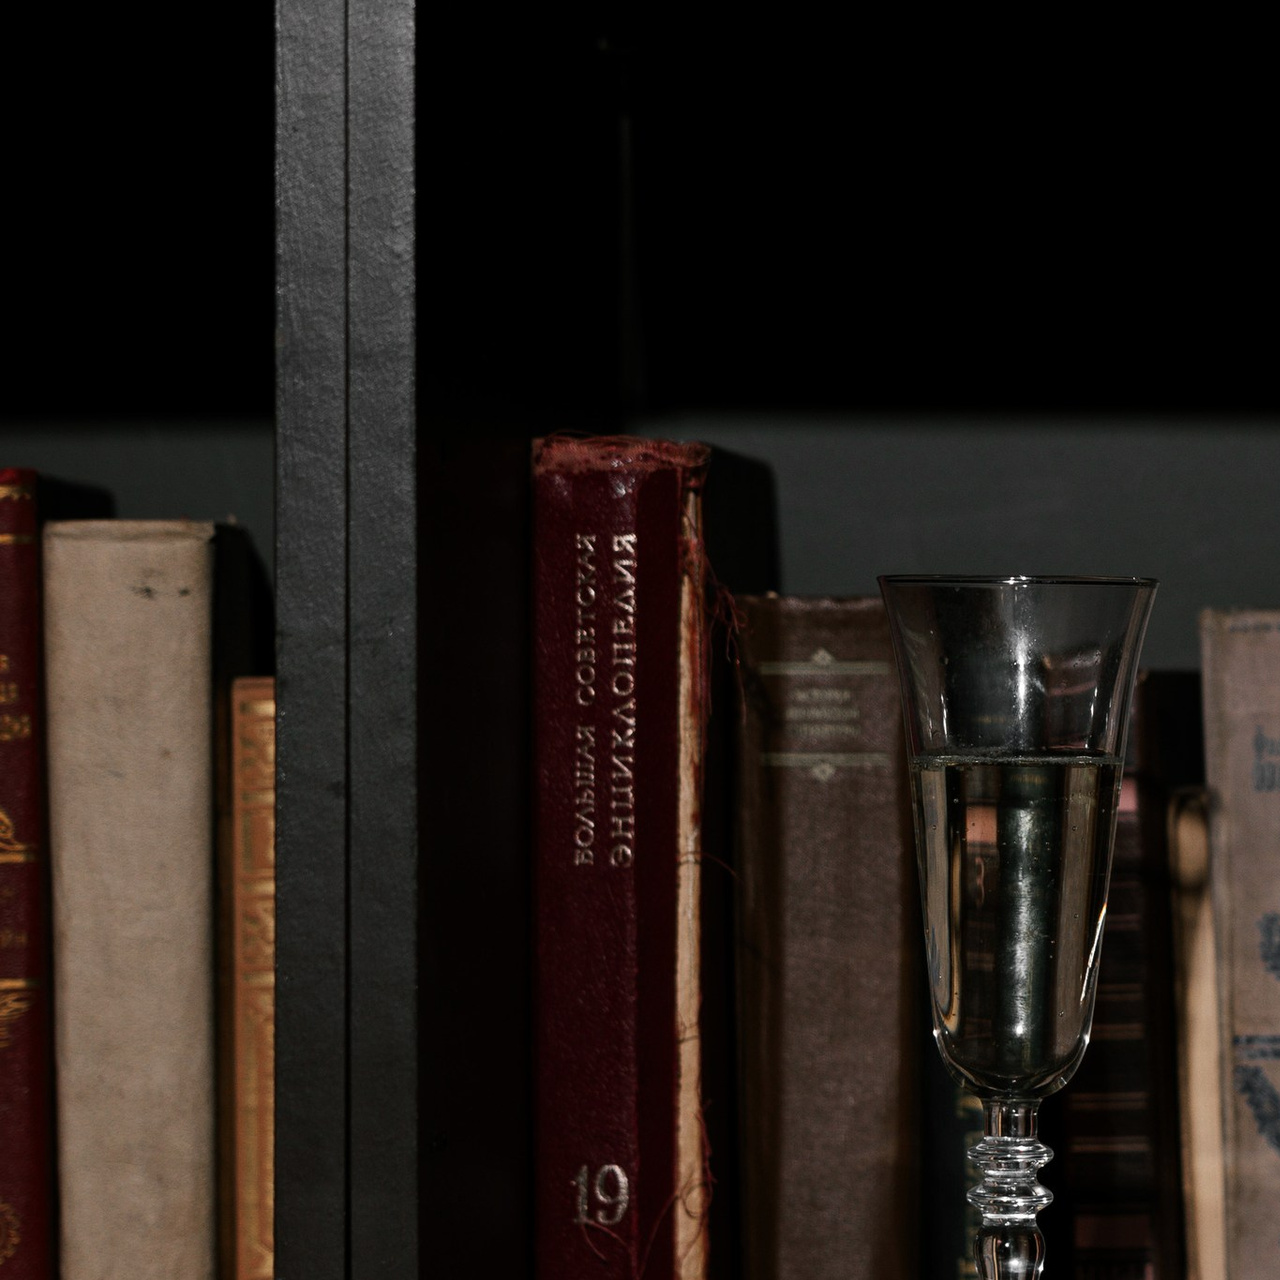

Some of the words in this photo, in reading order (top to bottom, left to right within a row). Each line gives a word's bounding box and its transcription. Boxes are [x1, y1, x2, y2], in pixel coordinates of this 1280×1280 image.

[574, 532, 598, 708] СОВЕТСКАЯ
[610, 531, 639, 869] ЭНЦИКЛОПЕДИЯ
[573, 723, 597, 868] БОЛЬШАЯ
[570, 1163, 630, 1226] 19
